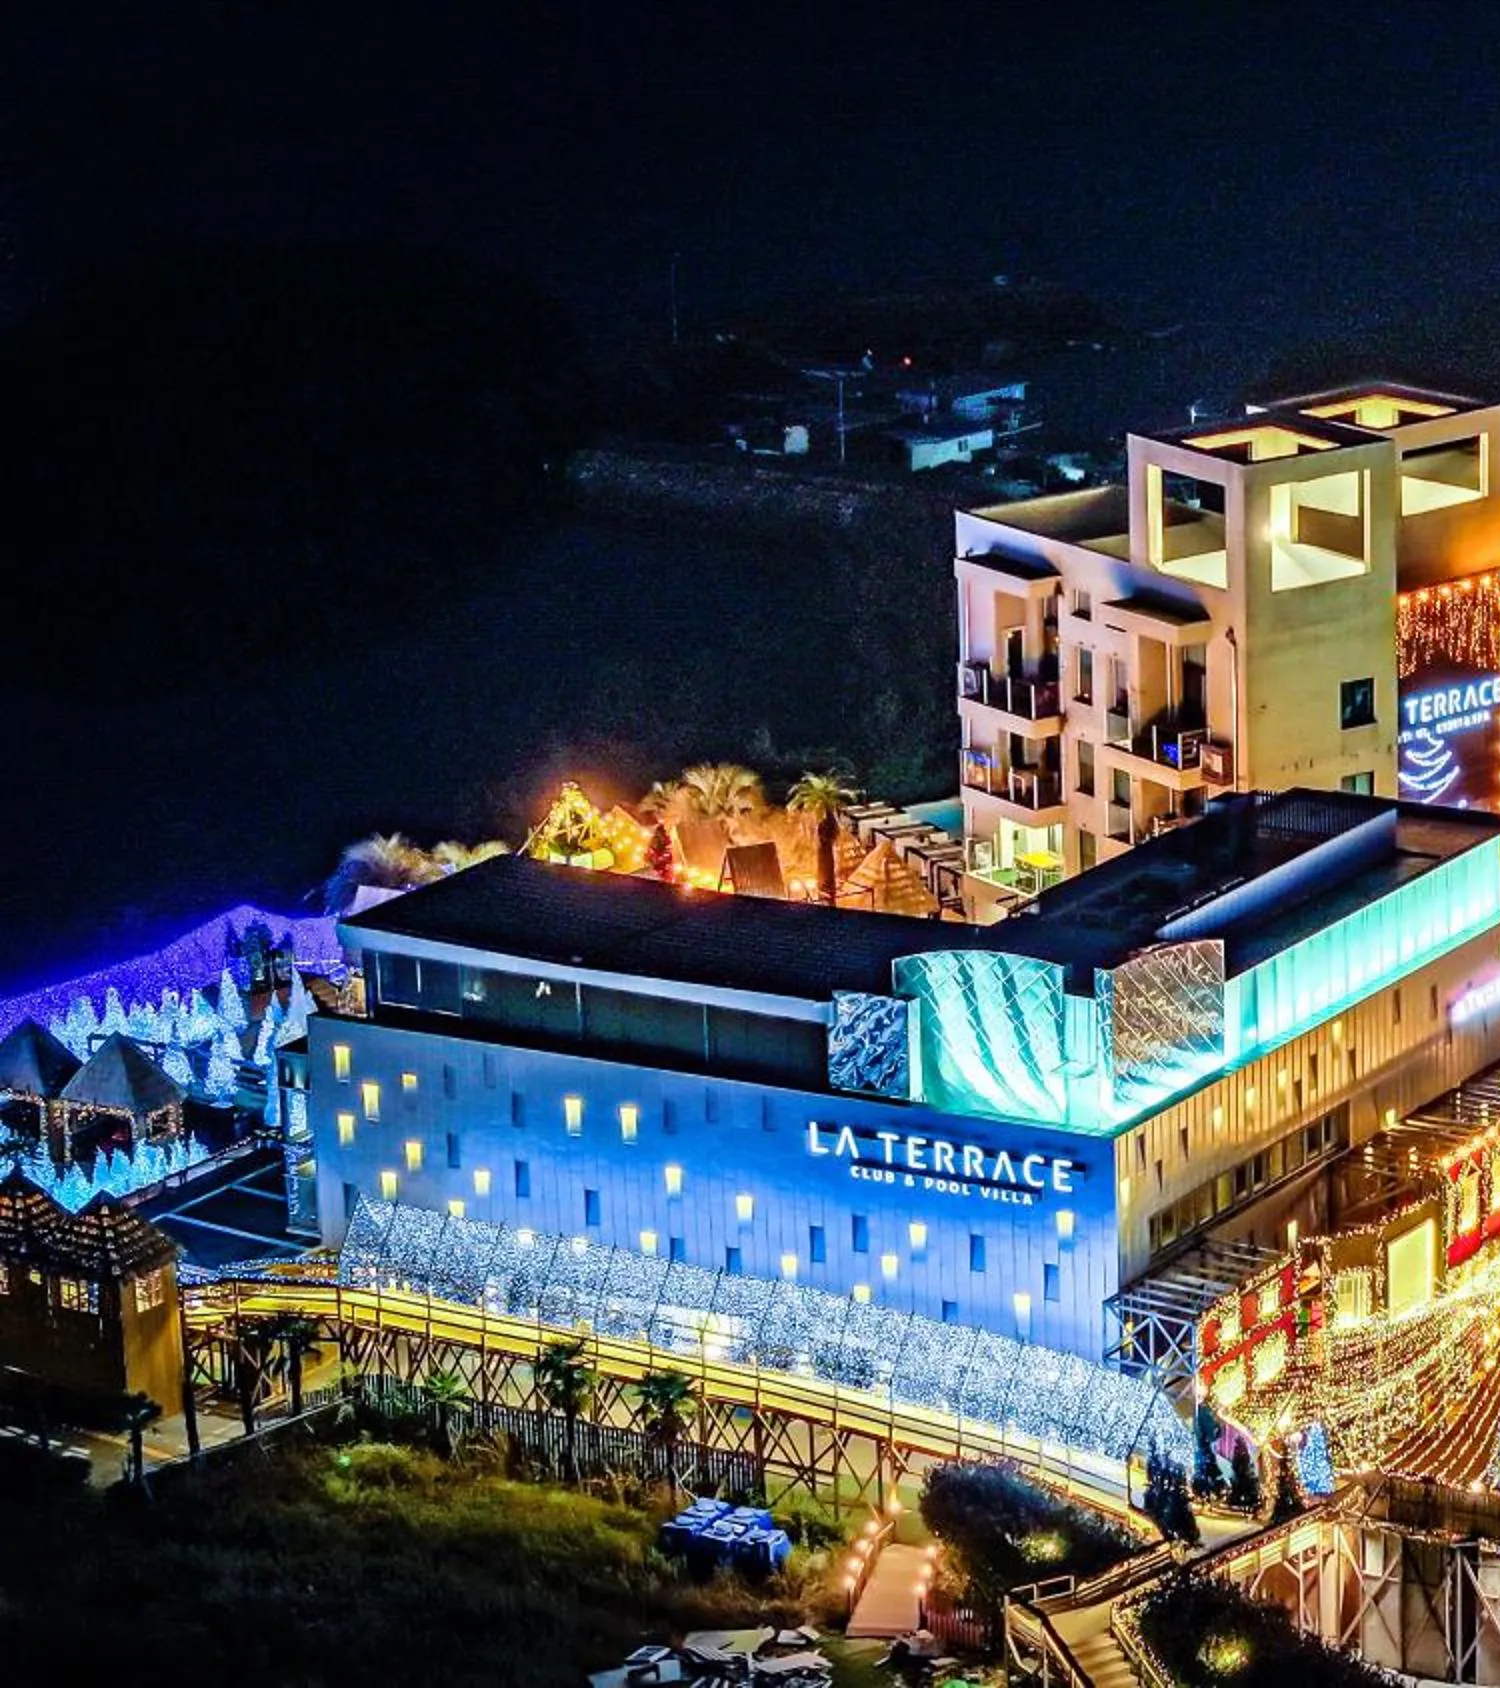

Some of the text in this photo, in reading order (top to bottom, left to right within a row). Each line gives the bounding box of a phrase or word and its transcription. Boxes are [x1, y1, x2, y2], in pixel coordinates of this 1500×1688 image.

[808, 1121, 1074, 1193] LA TERRACE
[851, 1165, 1034, 1206] CLUB & POOL VILLA
